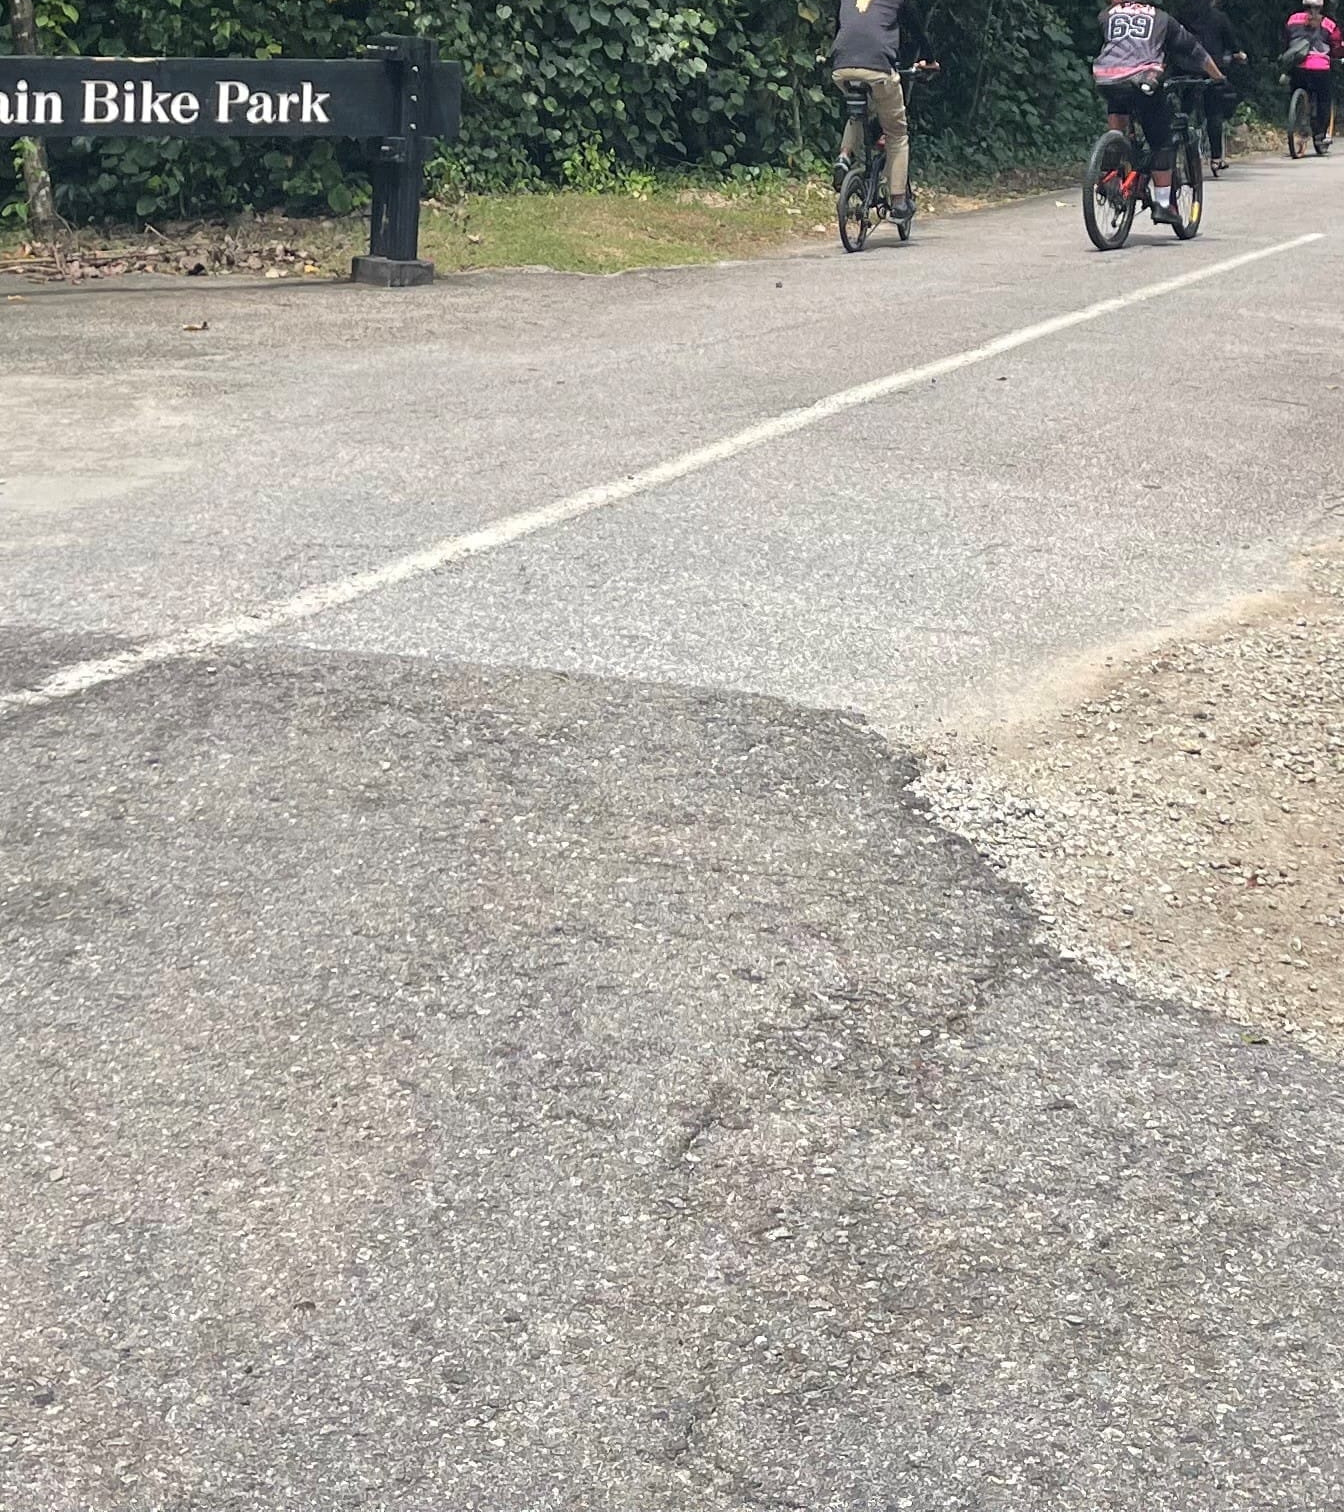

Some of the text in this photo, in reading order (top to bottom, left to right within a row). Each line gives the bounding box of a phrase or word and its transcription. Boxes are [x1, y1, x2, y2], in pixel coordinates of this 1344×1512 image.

[1108, 13, 1154, 41] 69
[80, 80, 201, 126] Bike
[214, 80, 332, 126] Park
